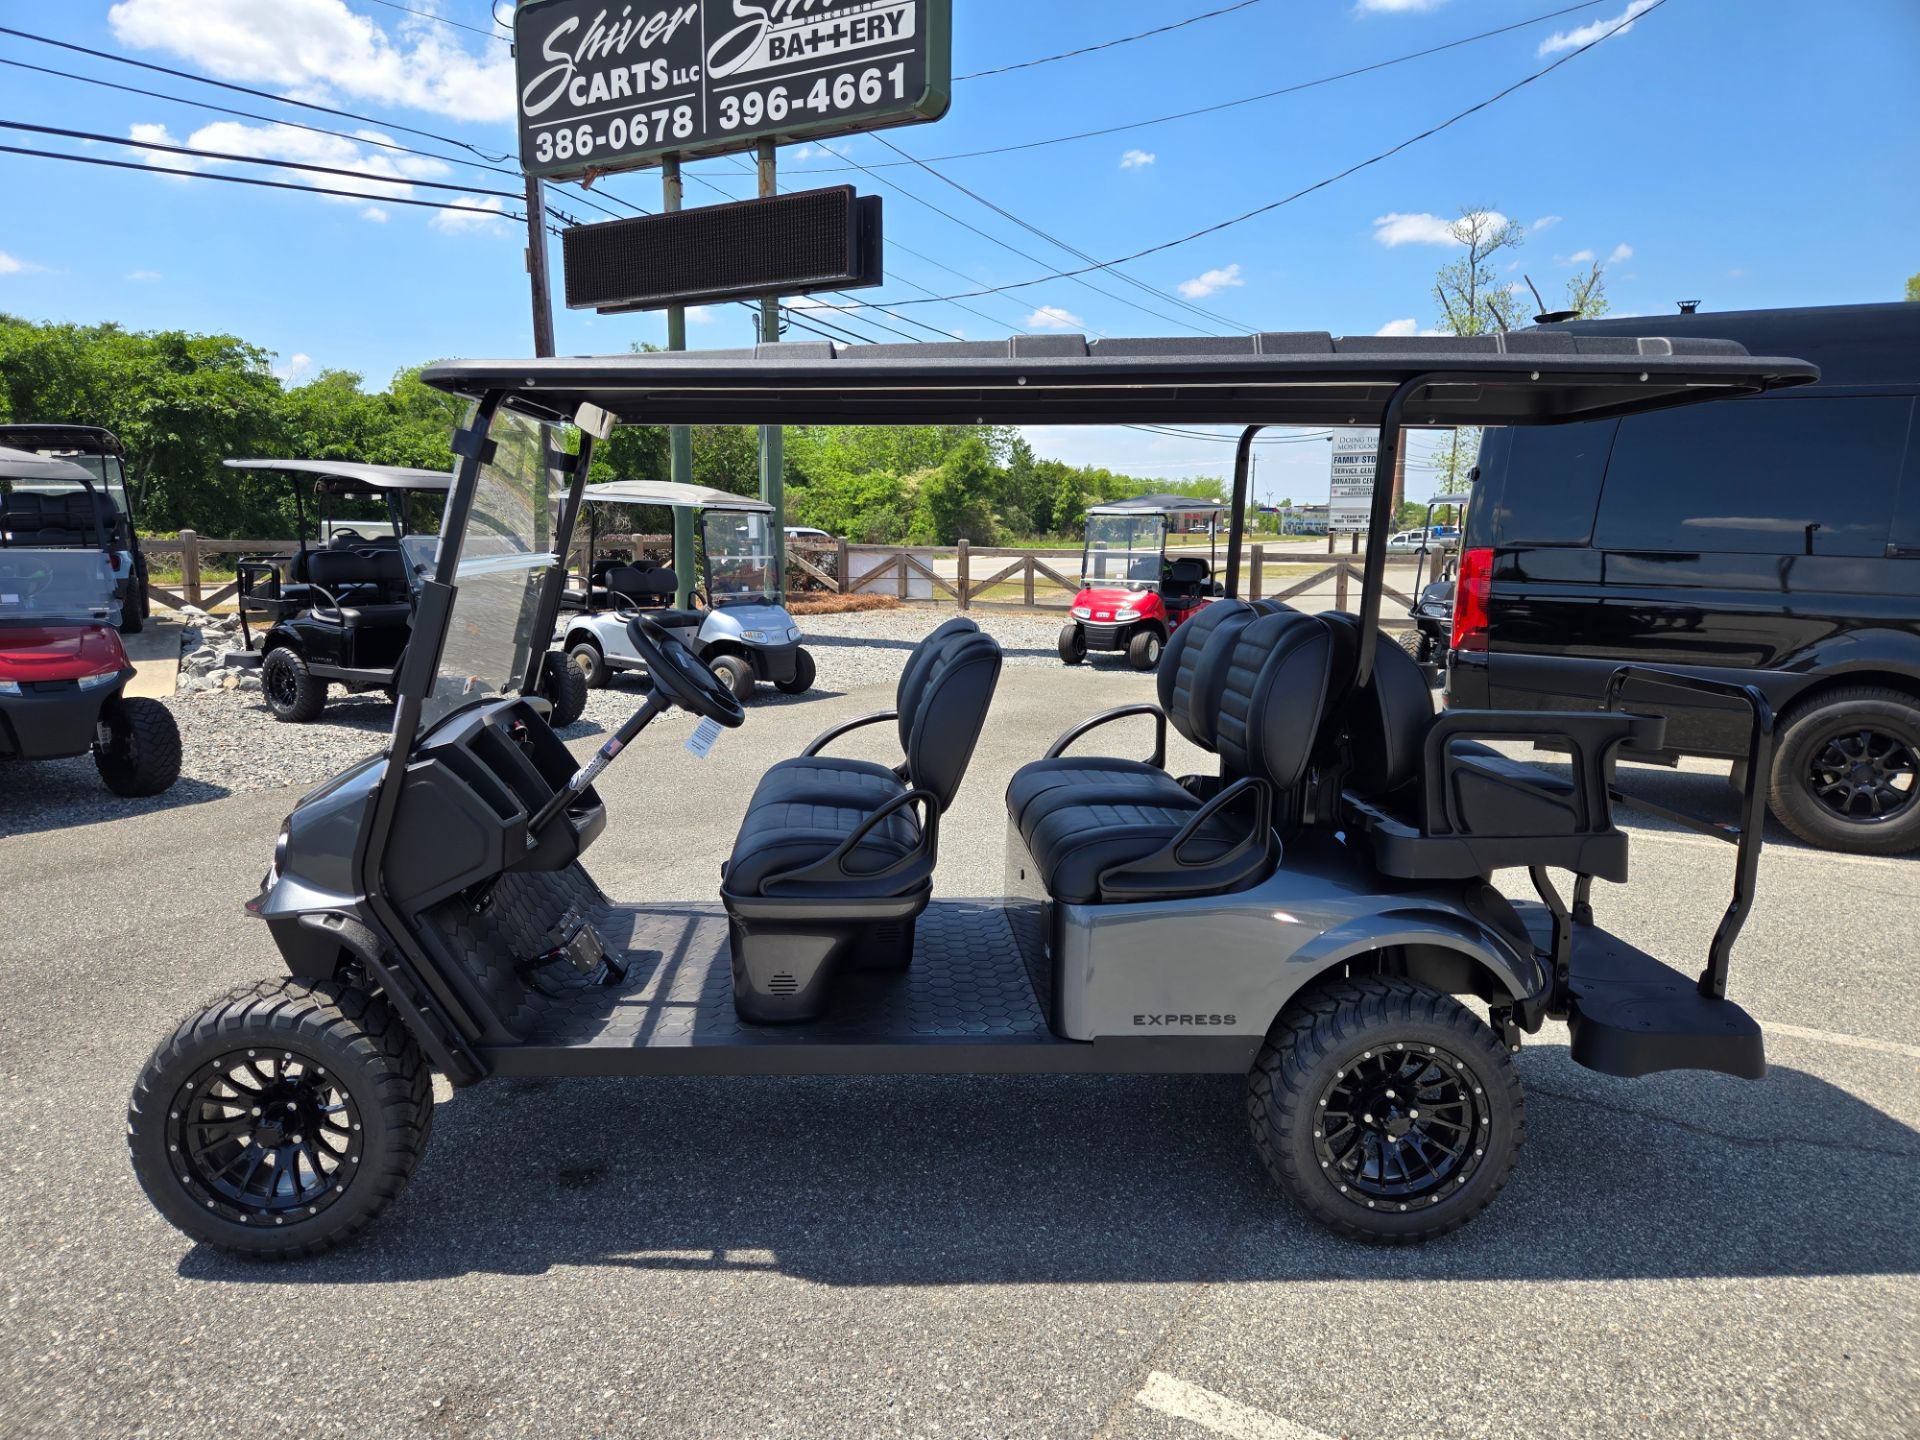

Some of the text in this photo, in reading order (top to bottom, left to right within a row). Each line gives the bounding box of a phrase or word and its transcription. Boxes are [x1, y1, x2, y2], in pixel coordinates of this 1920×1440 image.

[522, 3, 698, 117] Shiver
[568, 58, 700, 107] CARTS LLC
[718, 63, 906, 130] 396-4661
[535, 105, 694, 163] 386-0678
[1333, 455, 1377, 464] FAMILY STO
[1333, 467, 1376, 475] SERVICE CENT
[1331, 477, 1375, 485] DONATION CEN
[1133, 1014, 1237, 1026] EXPRESS
